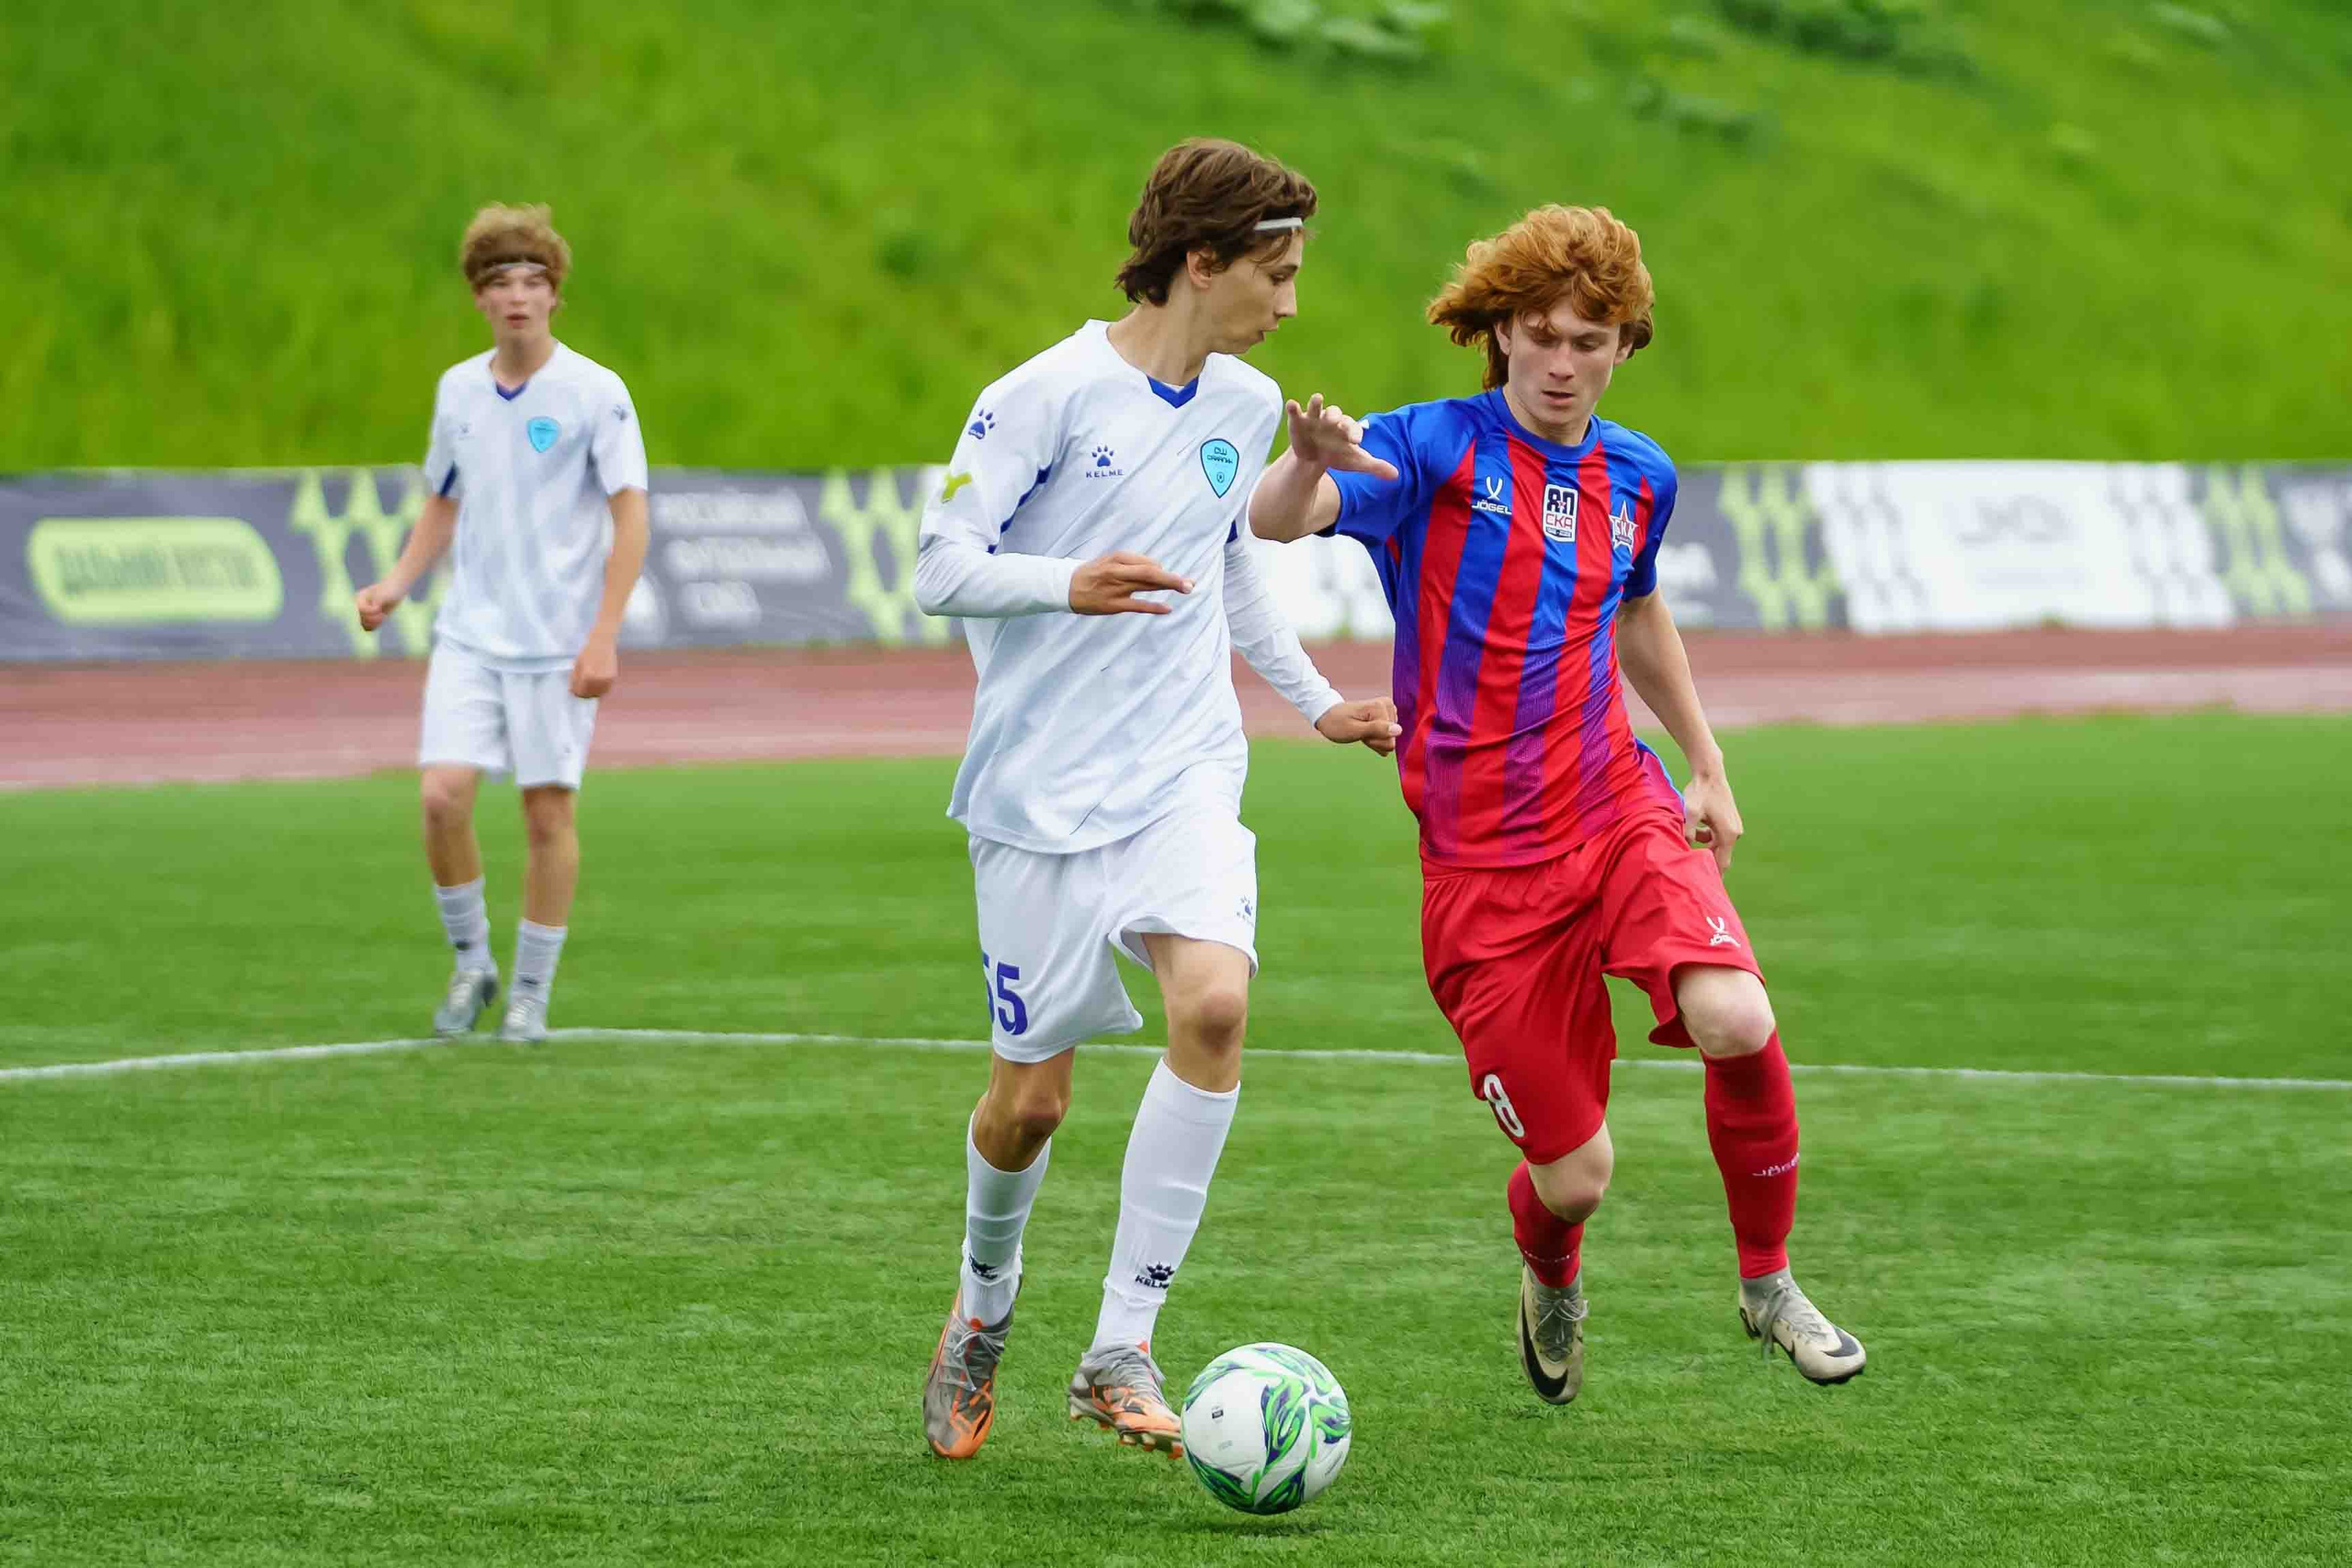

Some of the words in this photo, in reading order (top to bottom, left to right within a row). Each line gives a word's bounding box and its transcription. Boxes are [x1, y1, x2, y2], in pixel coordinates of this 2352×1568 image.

[1085, 468, 1125, 479] KELME
[1471, 499, 1512, 515] JÖGEL
[1483, 1074, 1525, 1138] 8
